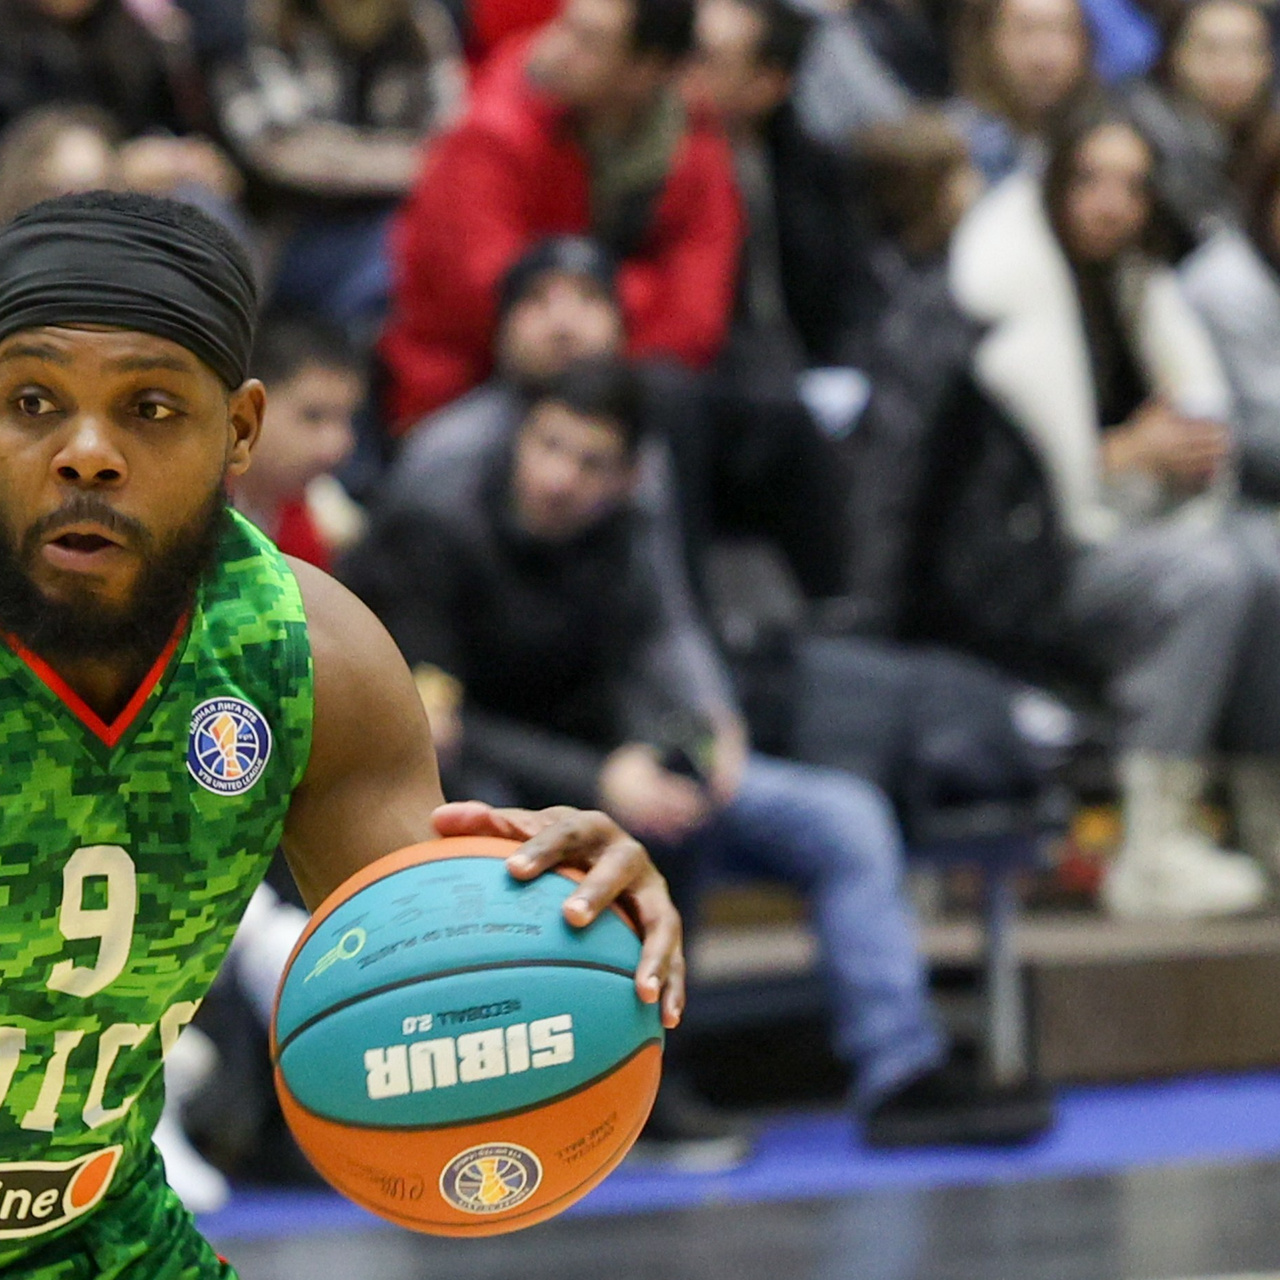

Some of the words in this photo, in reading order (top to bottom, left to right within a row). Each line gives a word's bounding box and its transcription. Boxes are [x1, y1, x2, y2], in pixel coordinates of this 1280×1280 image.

[217, 702, 241, 713] ЛИГА
[212, 778, 243, 791] UNITED
[46, 844, 136, 998] 9
[363, 1013, 575, 1101] SIBUR
